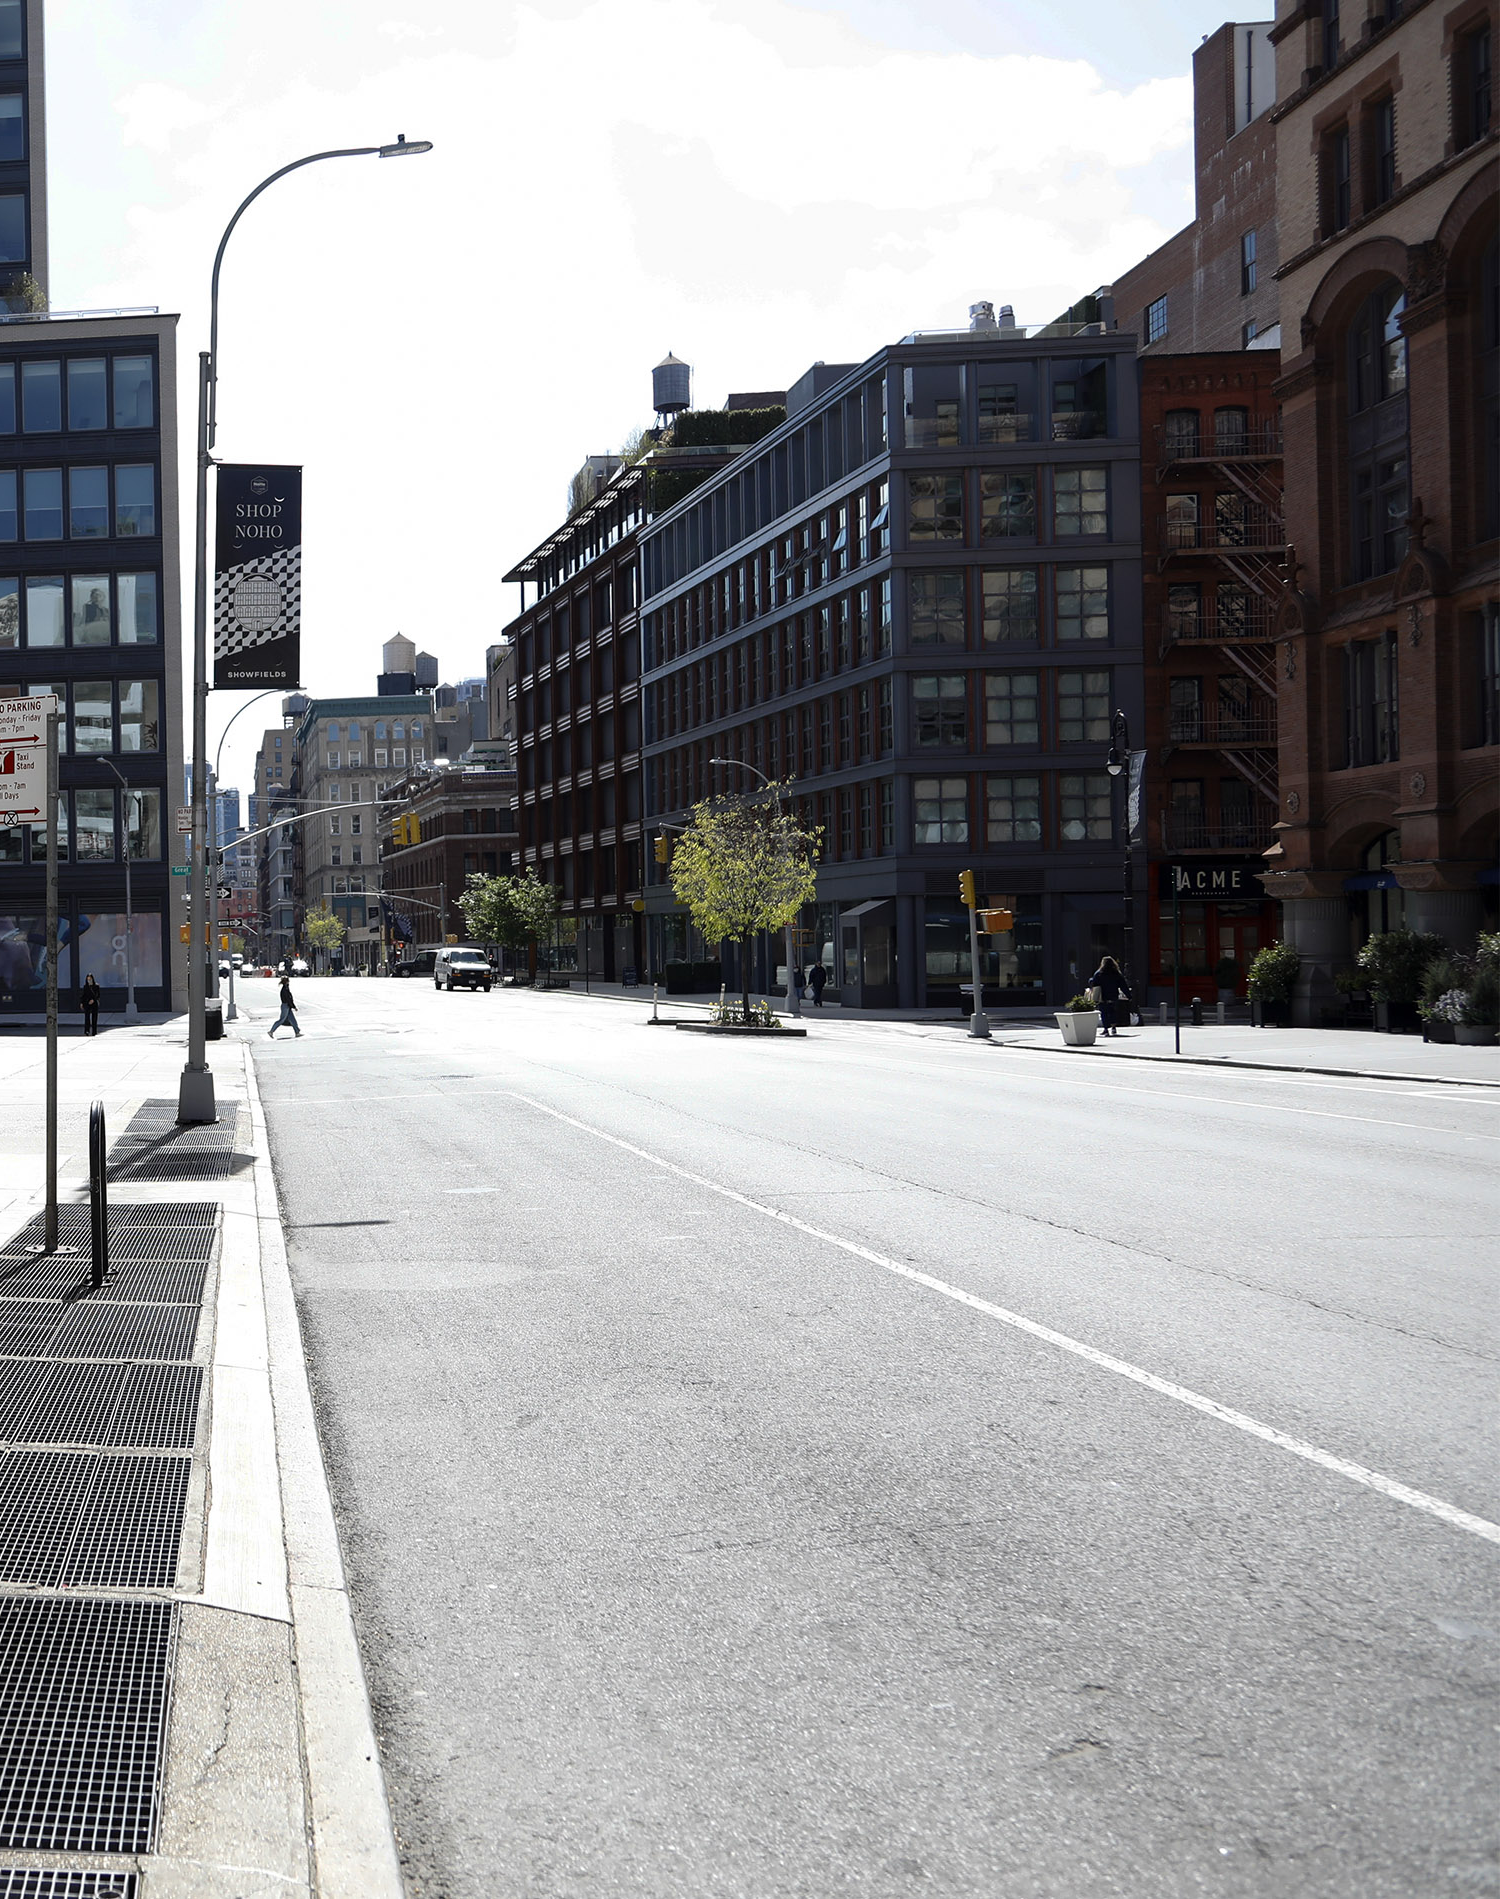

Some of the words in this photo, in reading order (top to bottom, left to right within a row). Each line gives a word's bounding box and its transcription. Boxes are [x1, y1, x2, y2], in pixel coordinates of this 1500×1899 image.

[236, 504, 282, 518] SHOP
[235, 524, 283, 539] NOHO
[7, 701, 41, 712] PARKING
[22, 714, 41, 723] Friday
[12, 725, 25, 733] 7pm
[17, 753, 29, 761] Taxi
[17, 762, 35, 770] Stand
[4, 792, 19, 801] Days
[1181, 871, 1241, 888] ACME
